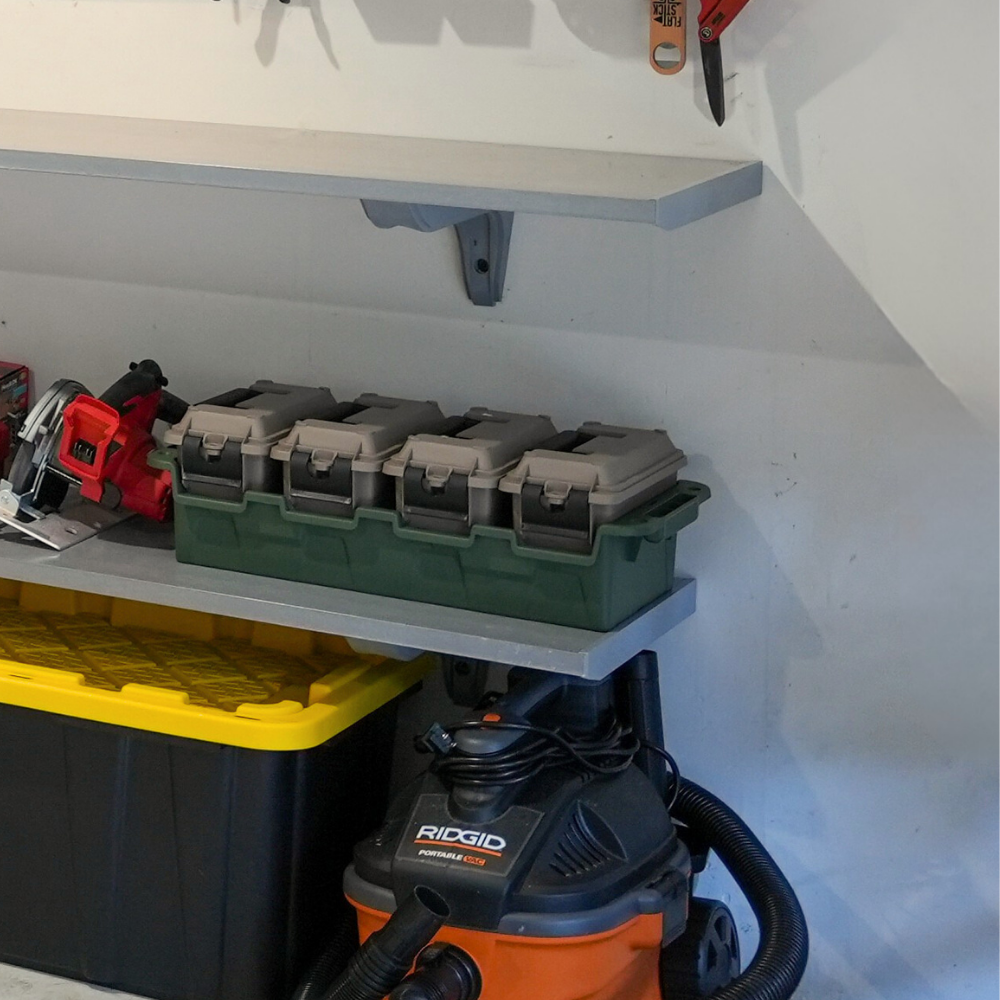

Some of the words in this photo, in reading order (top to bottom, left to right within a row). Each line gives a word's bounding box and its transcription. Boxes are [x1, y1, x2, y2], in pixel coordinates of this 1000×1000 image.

[652, 3, 677, 16] STICK
[662, 15, 682, 28] FLAT
[415, 824, 507, 851] RIDGID
[418, 848, 464, 861] PORTABLE
